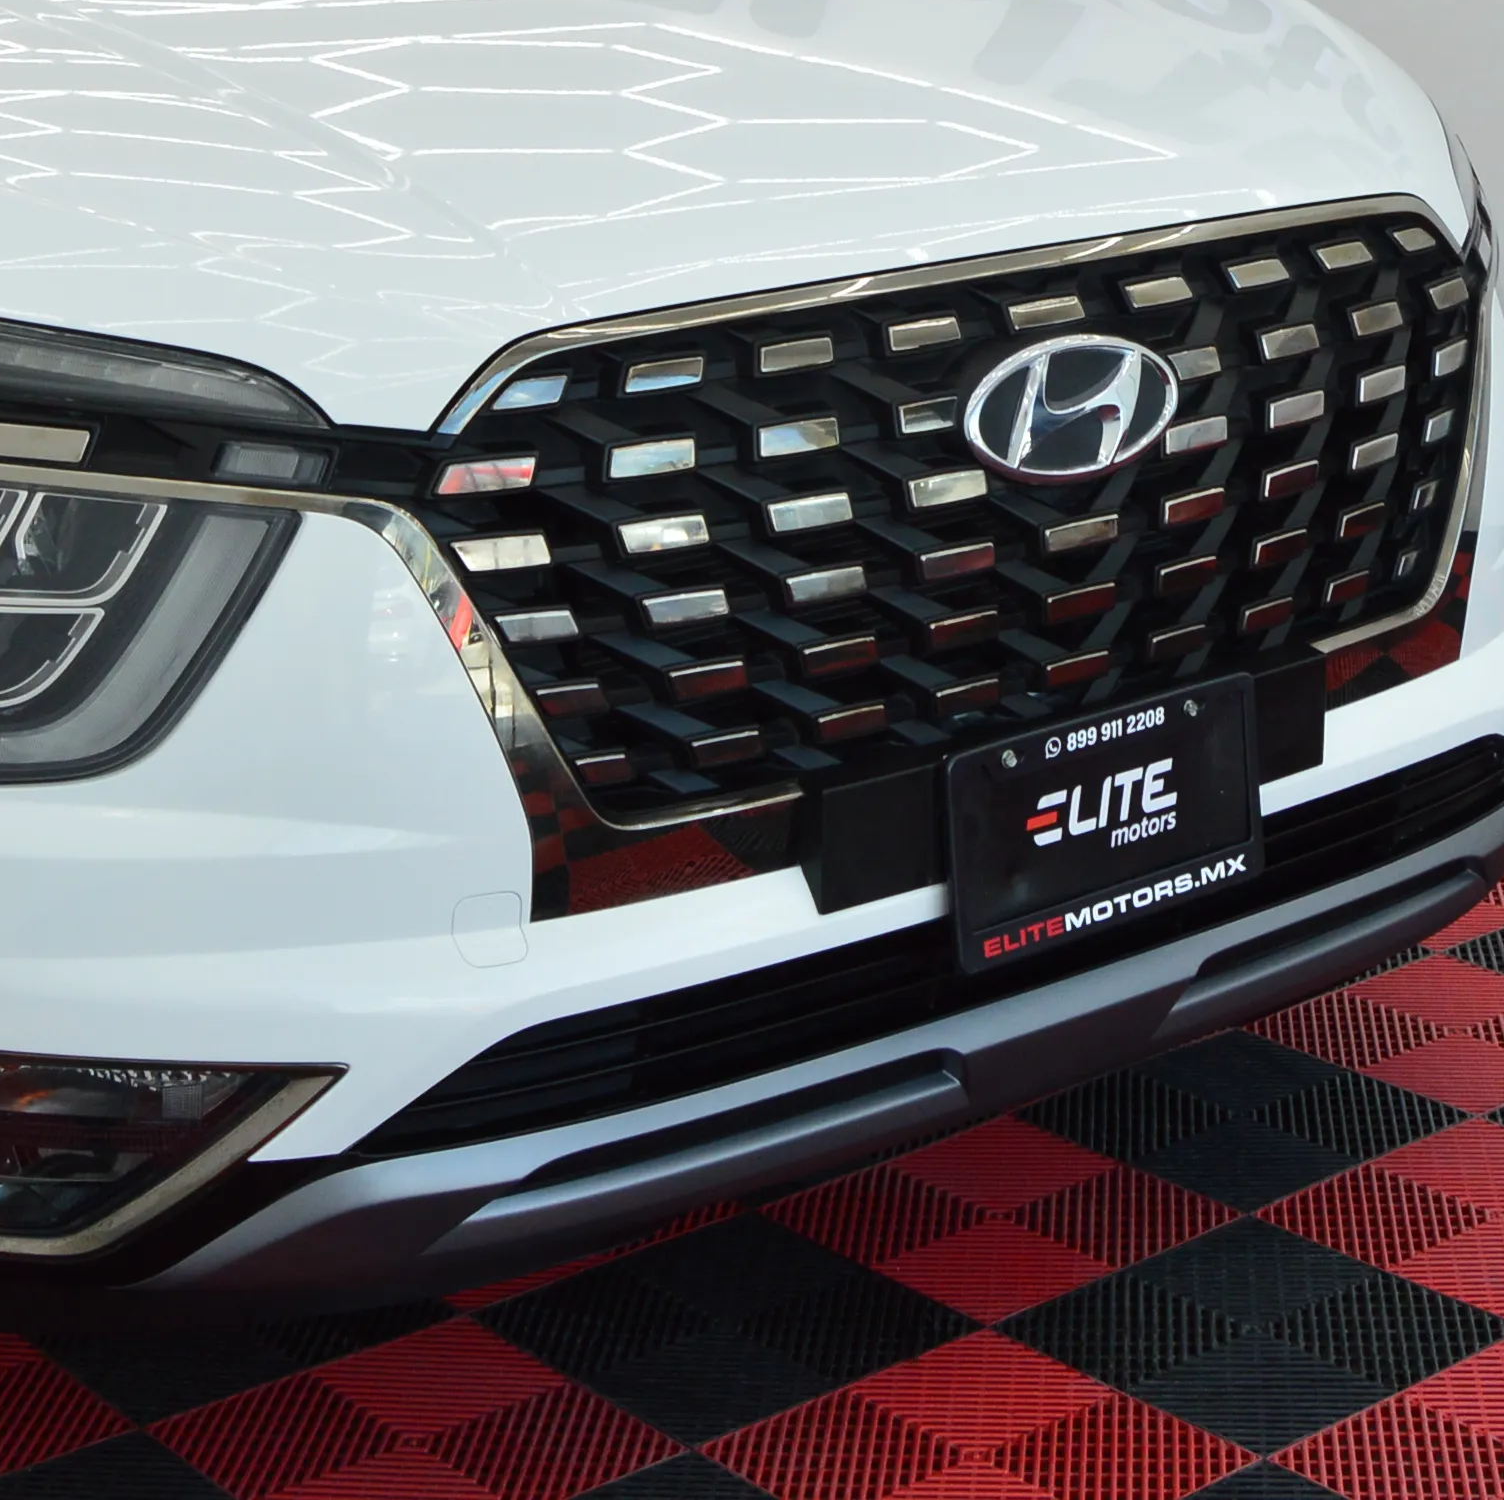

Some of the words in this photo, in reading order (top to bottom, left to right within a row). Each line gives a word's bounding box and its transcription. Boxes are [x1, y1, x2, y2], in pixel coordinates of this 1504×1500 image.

[1066, 727, 1097, 752] 899
[1100, 717, 1123, 741] 911
[1126, 706, 1165, 735] 2208
[1026, 758, 1178, 847] ELITE
[1110, 811, 1177, 848] motors
[983, 854, 1246, 959] ELITEMOTORS.MX
